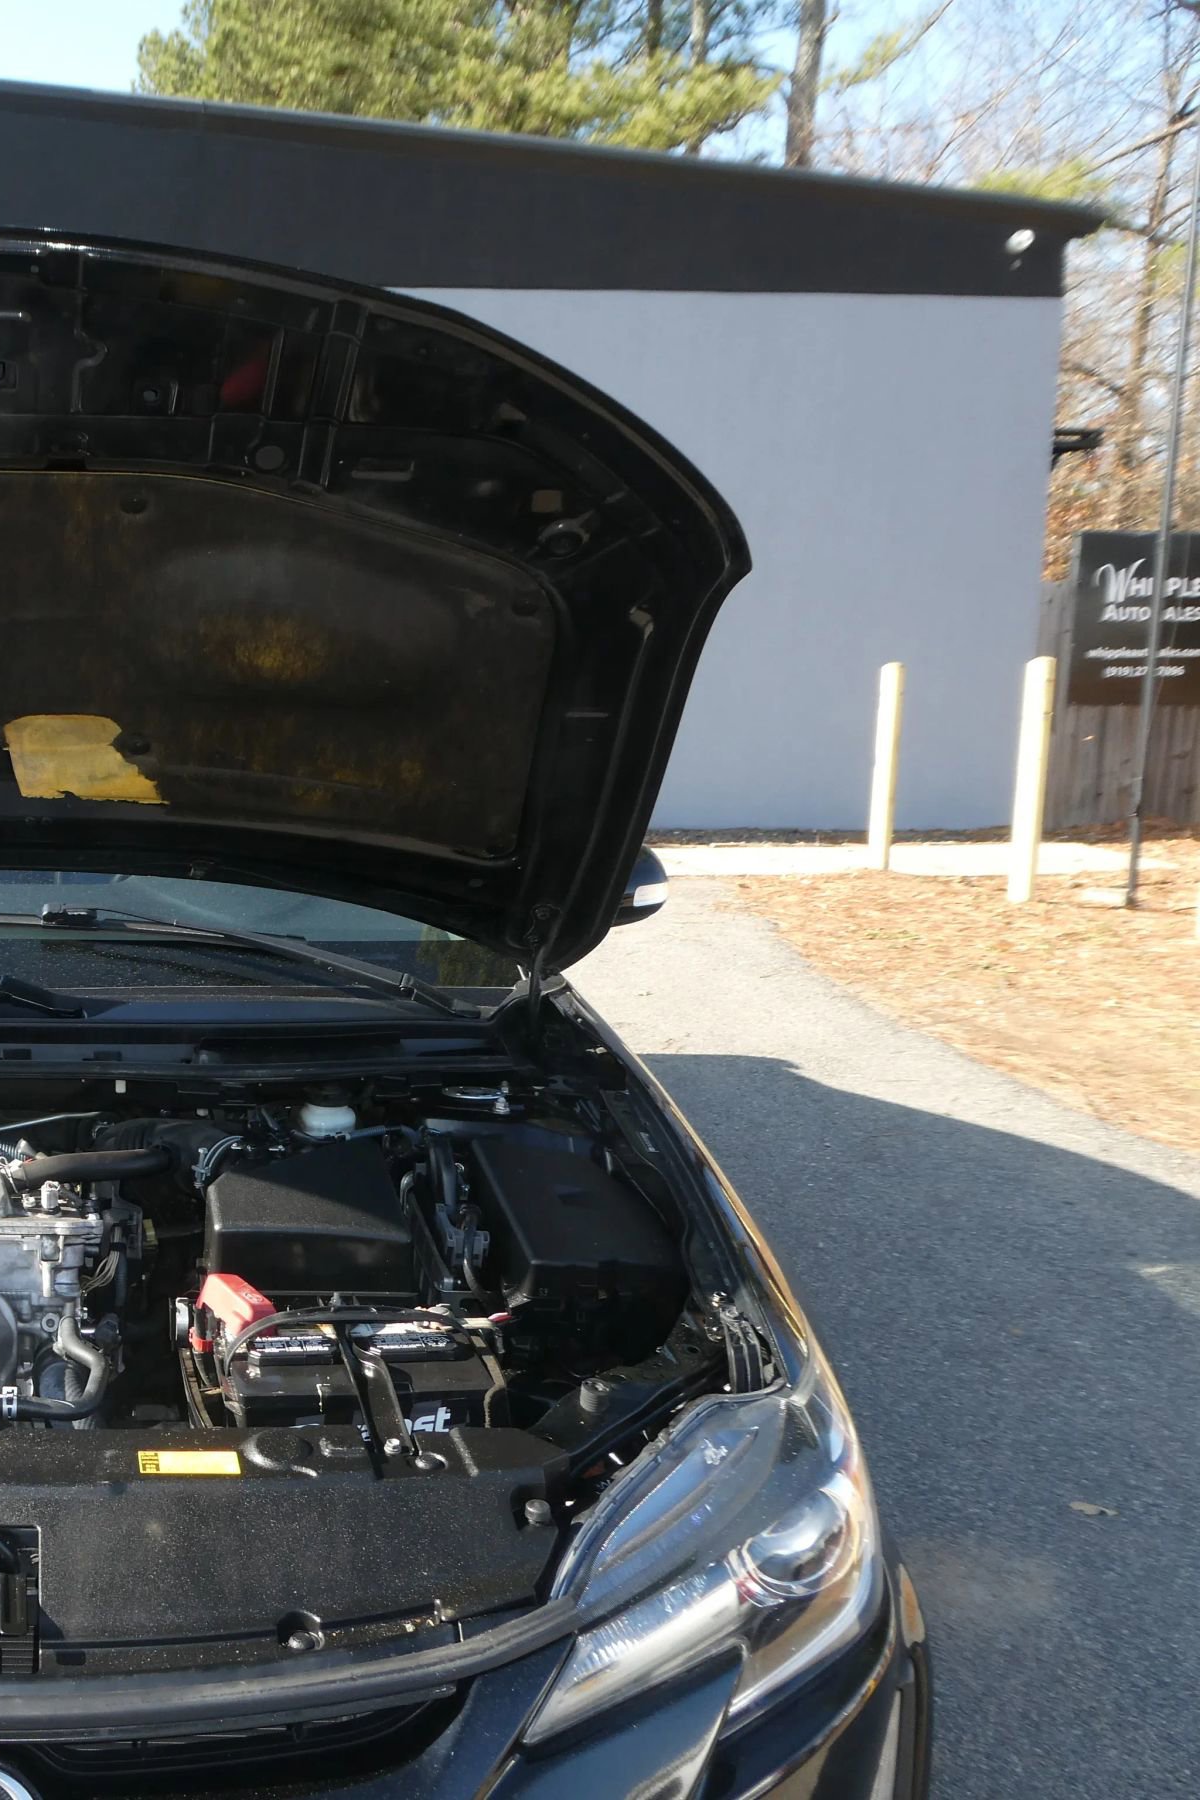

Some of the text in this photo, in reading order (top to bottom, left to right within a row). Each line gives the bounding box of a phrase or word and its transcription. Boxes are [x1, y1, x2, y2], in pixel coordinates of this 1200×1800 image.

[1092, 558, 1200, 603] WHIPLE
[1099, 603, 1200, 622] AUTO ALES
